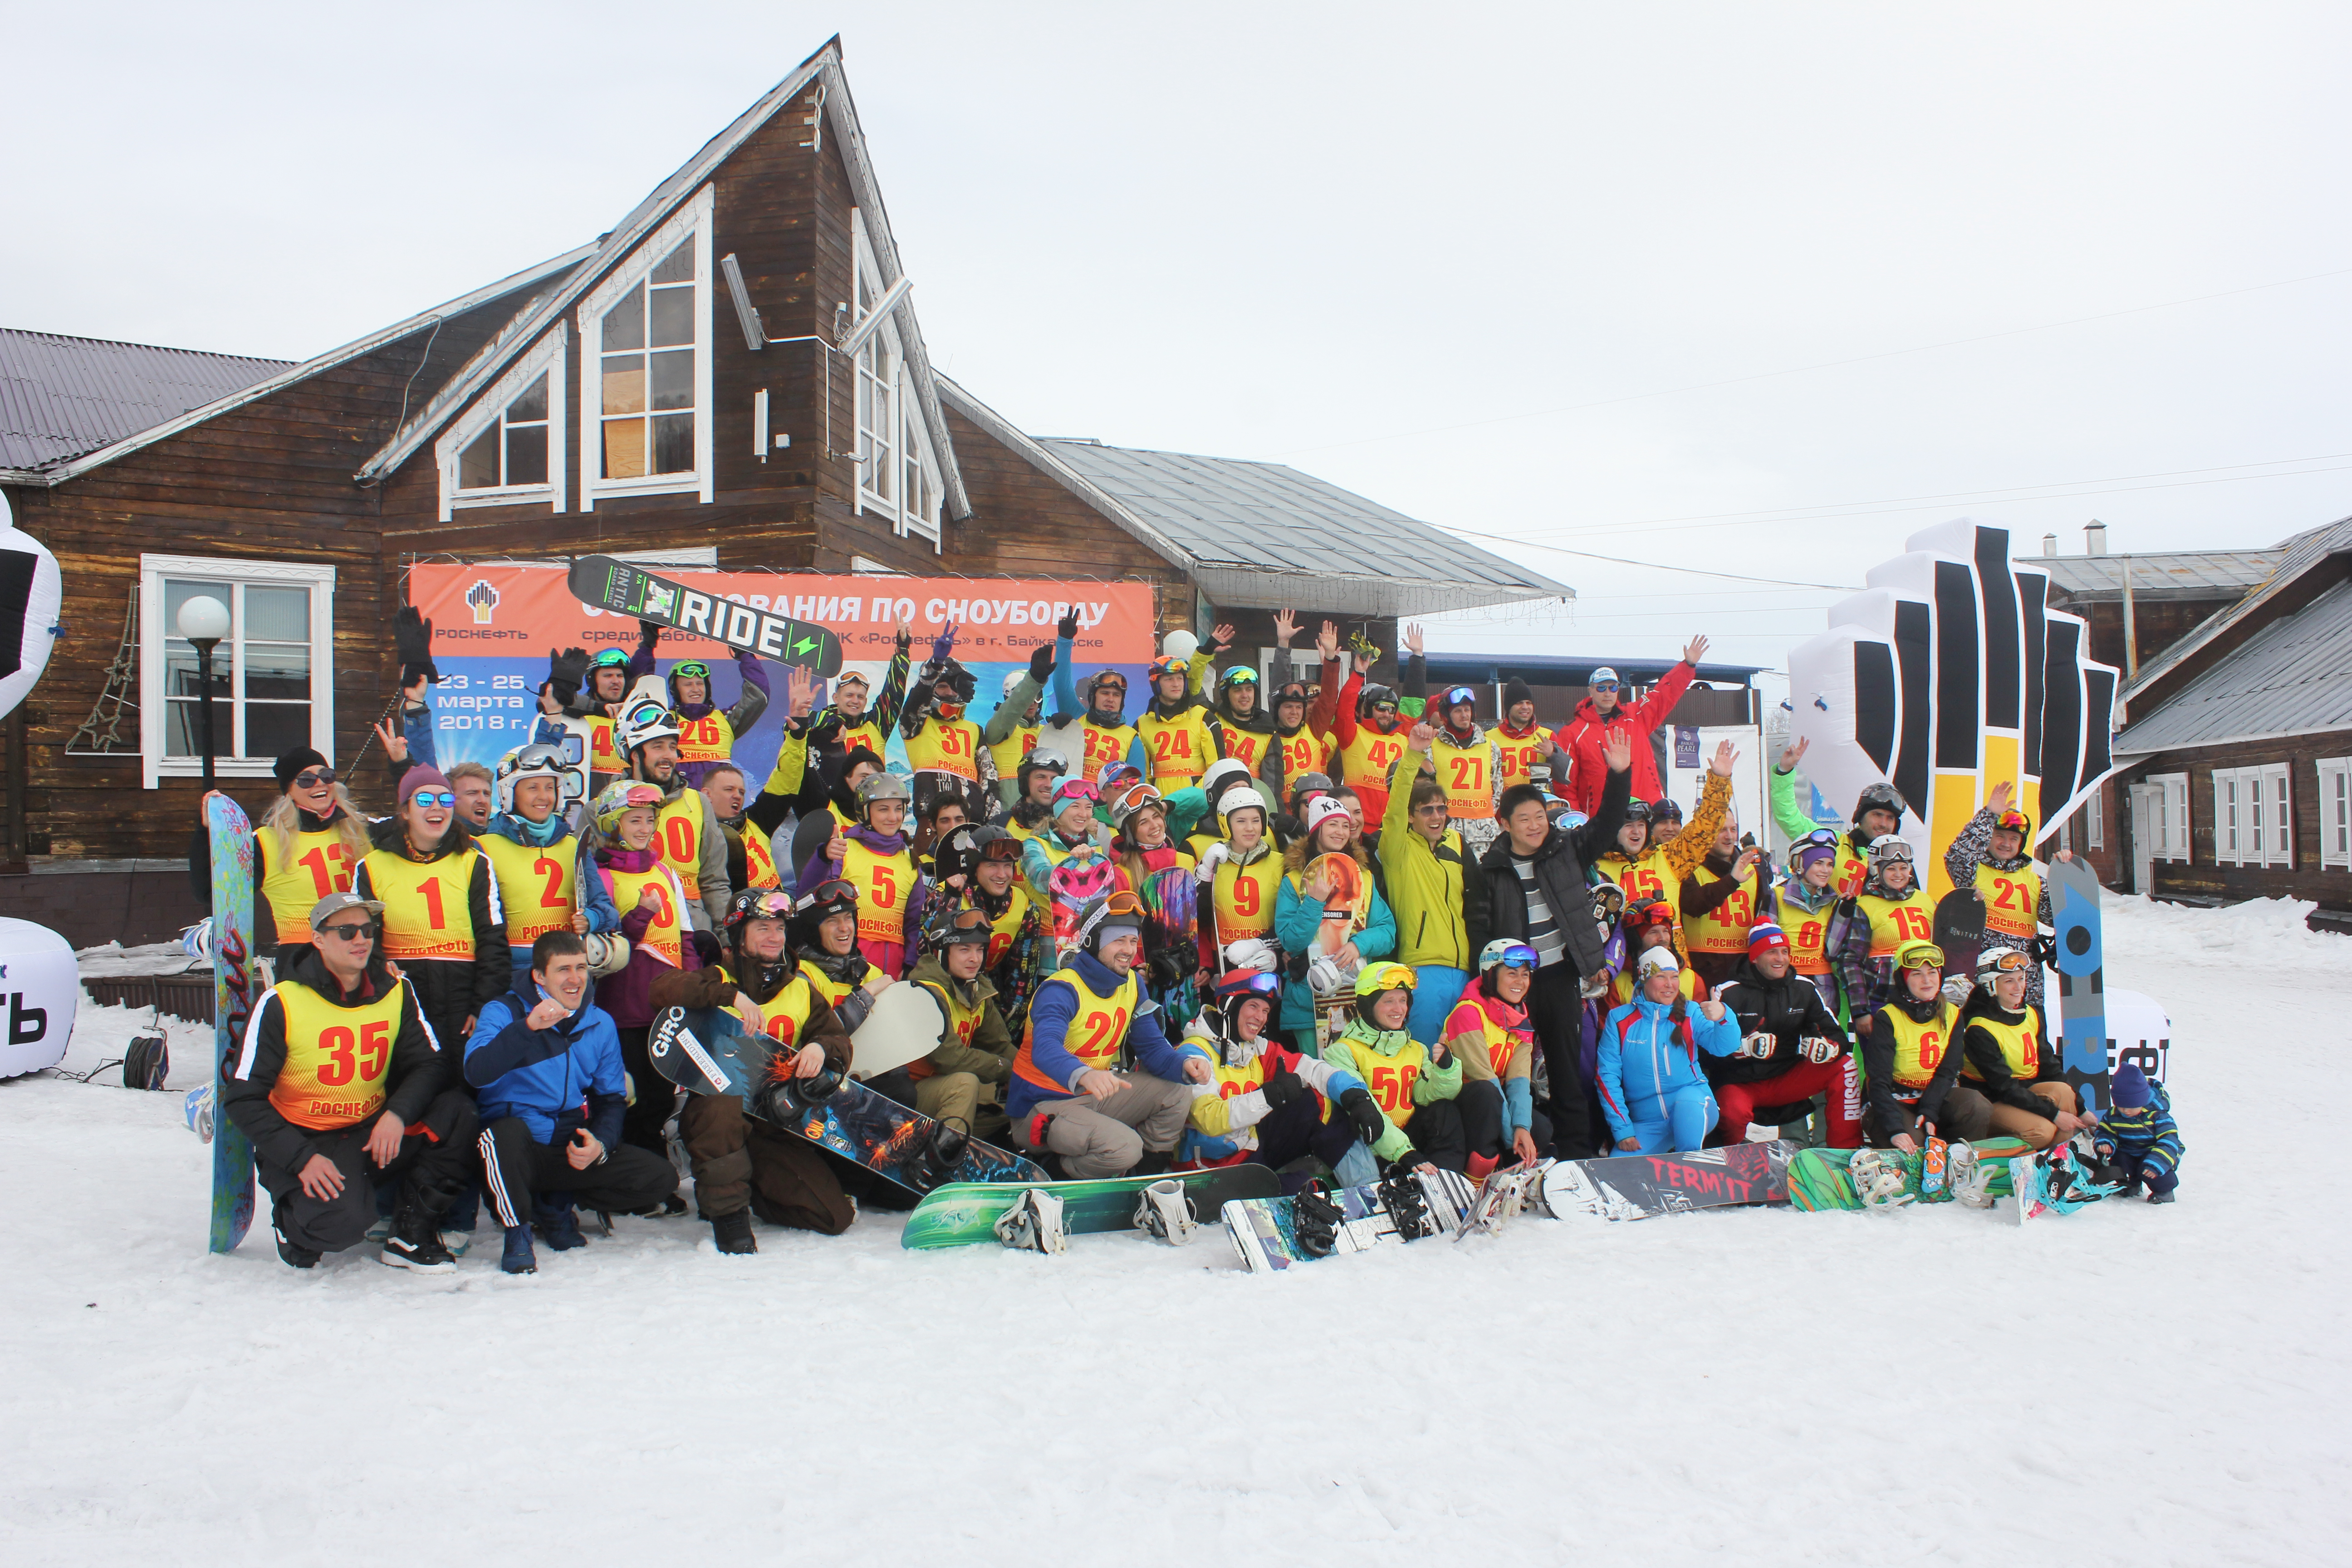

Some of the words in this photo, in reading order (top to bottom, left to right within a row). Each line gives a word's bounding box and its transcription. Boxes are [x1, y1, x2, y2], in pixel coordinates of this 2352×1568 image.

[612, 568, 631, 609] ANTIC
[679, 590, 786, 657] RIDE
[871, 598, 915, 623] ПО
[925, 598, 1109, 630] СНОУБОРДУ
[436, 629, 528, 639] РОСНЕФТЬ
[976, 637, 985, 645] в
[436, 675, 469, 689] 23
[493, 675, 524, 689] 25
[438, 696, 524, 712] марта
[440, 716, 505, 730] 2018
[511, 720, 528, 730] г.
[678, 717, 720, 745] 26
[681, 750, 720, 759] СНЕФТЬ
[939, 725, 971, 758] 37
[1154, 729, 1192, 762] 24
[1367, 740, 1403, 769] 42
[938, 760, 976, 778] РОСНЕФТЬ
[1450, 757, 1483, 789] 27
[1501, 747, 1536, 776] 59
[1446, 799, 1487, 808] РОСНЕФТЬ
[298, 843, 358, 900] 13
[534, 857, 568, 908] 2
[871, 866, 896, 908] 5
[1620, 870, 1663, 903] 45
[416, 877, 446, 930] 1
[1233, 876, 1260, 917] 9
[1709, 890, 1753, 927] 43
[1993, 878, 2032, 914] 21
[1798, 921, 1822, 948] 8
[1889, 907, 1931, 941] 15
[1986, 913, 2036, 932] РОСНЕФТЬ
[1706, 937, 1750, 948] РОСНЕФТ
[652, 1005, 686, 1058] GIRO
[1075, 1006, 1127, 1058] 22
[317, 1020, 389, 1086] 35
[679, 1034, 717, 1078] FREERIDING
[1919, 1031, 1940, 1069] 6
[1372, 1065, 1418, 1111] 56
[309, 1093, 381, 1117] РОСНЕФТЬ
